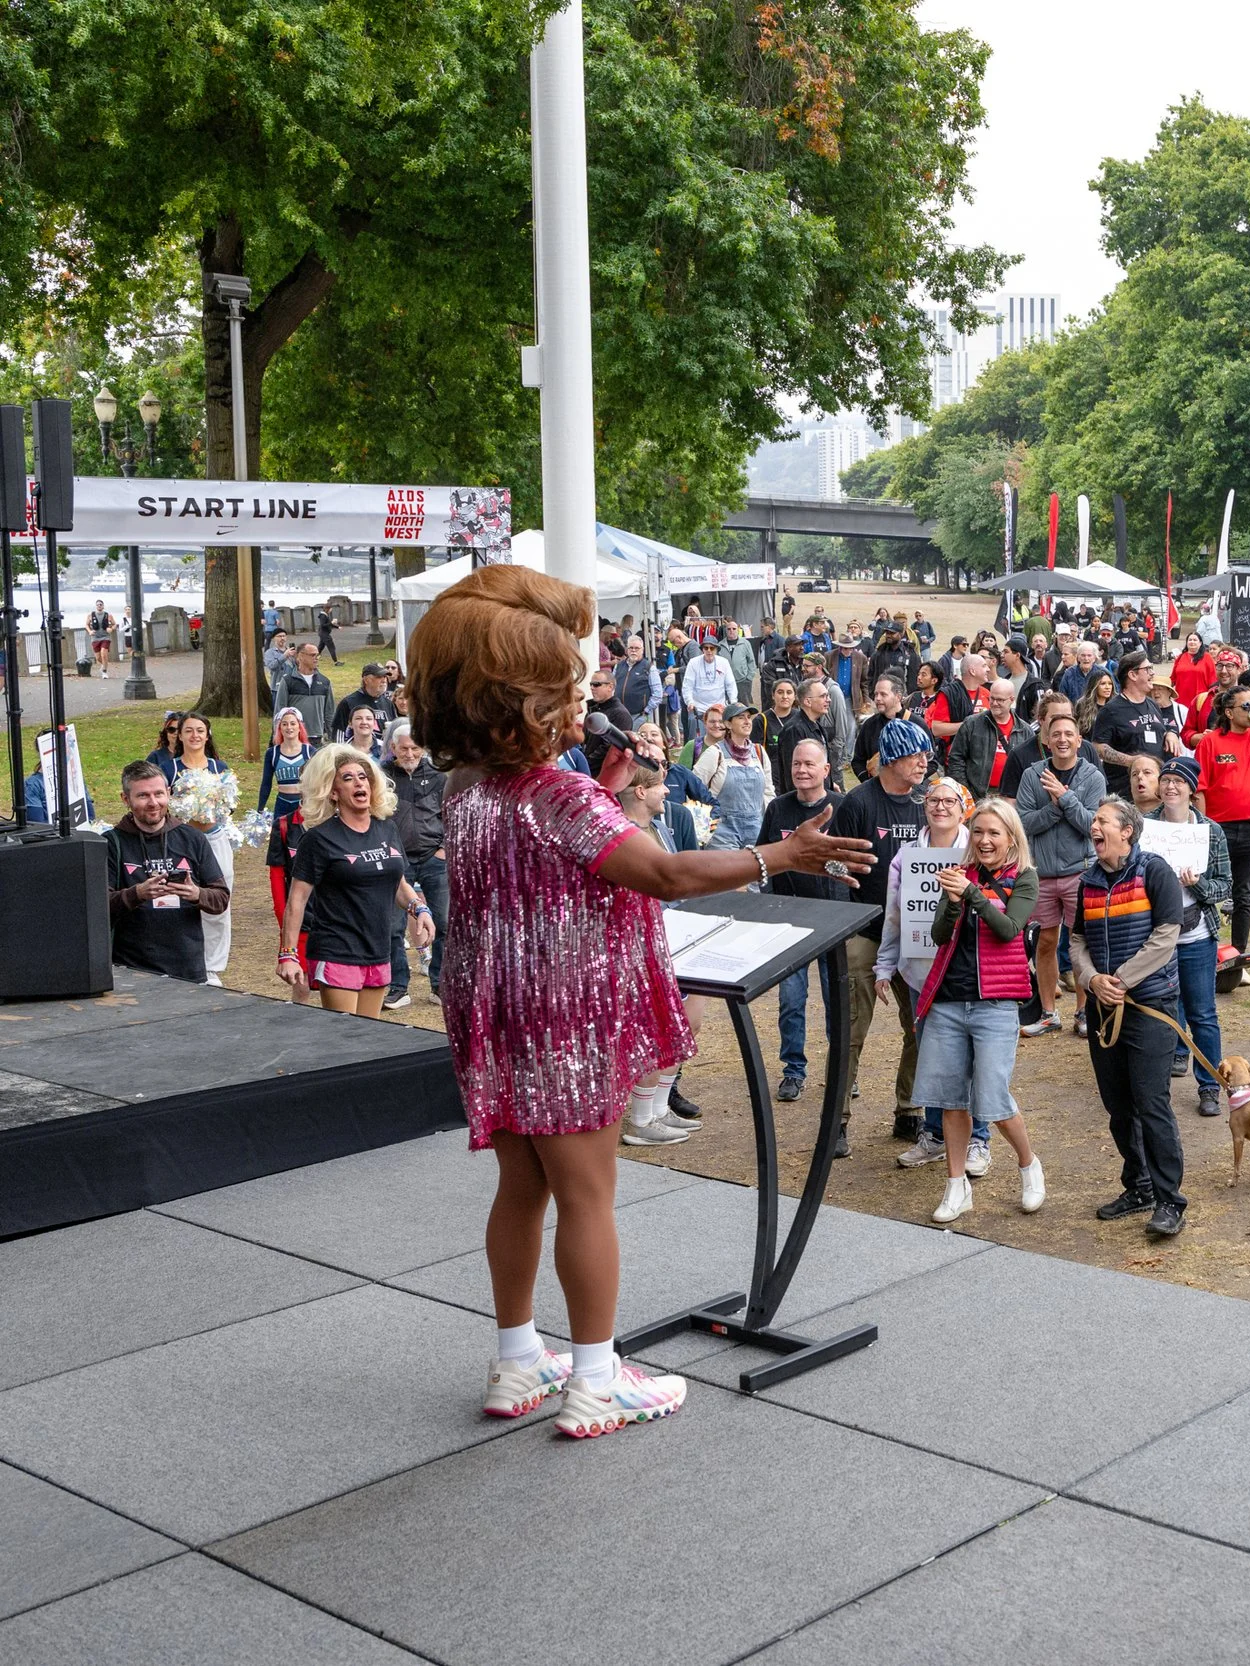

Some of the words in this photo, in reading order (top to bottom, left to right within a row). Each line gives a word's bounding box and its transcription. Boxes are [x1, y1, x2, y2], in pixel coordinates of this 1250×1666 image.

[387, 490, 424, 502] AIDS
[138, 497, 244, 518] START
[253, 499, 317, 519] LINE
[387, 503, 425, 515] WALK
[385, 517, 424, 526] NORTH
[384, 527, 423, 539] WEST
[892, 828, 917, 838] LIFE
[1169, 829, 1208, 845] Sucks
[361, 850, 389, 862] LIFE
[907, 900, 937, 912] STIG
